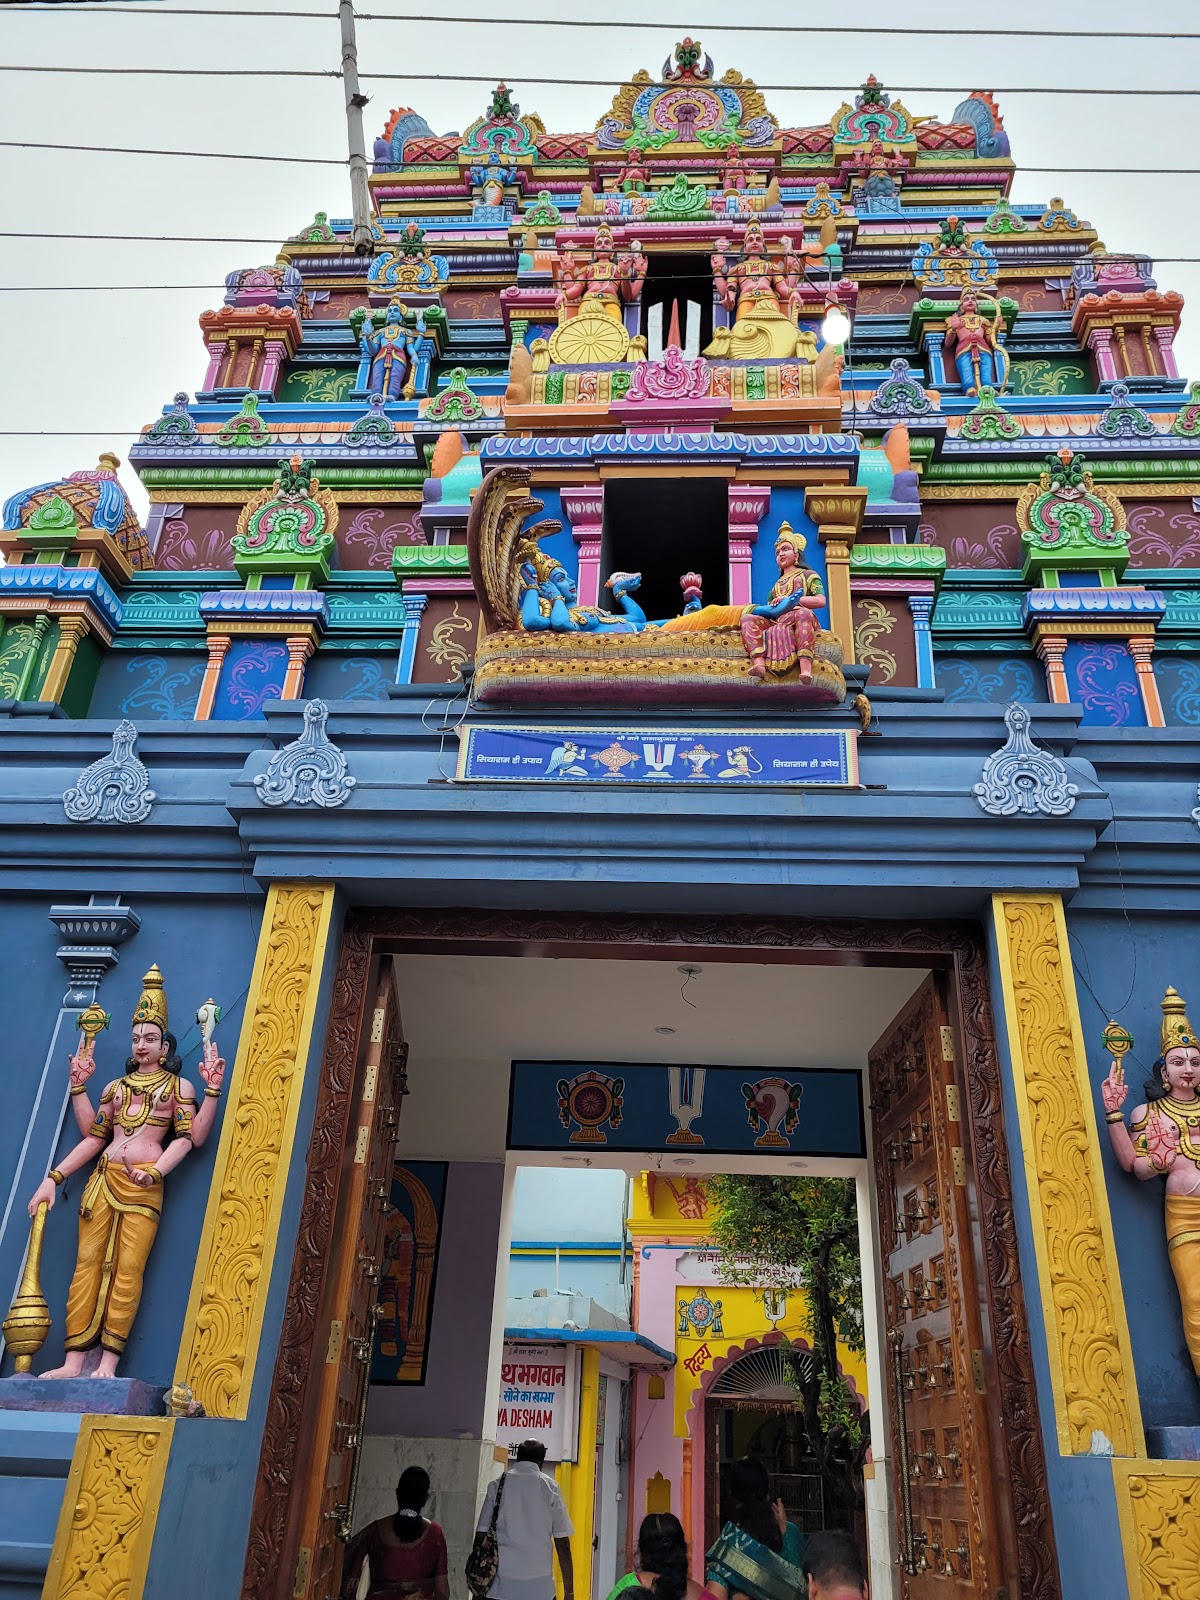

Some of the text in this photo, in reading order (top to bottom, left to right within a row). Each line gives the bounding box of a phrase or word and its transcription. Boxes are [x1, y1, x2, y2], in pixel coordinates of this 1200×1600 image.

[476, 754, 511, 764] सियाराम
[511, 754, 521, 764] ही
[773, 758, 840, 768] सियाराम ही उपेय
[683, 1342, 713, 1377] दिव्य
[518, 1365, 566, 1386] भगवान
[503, 1387, 520, 1403] सोने
[520, 1390, 532, 1403] का
[510, 1409, 553, 1429] DESHAM
